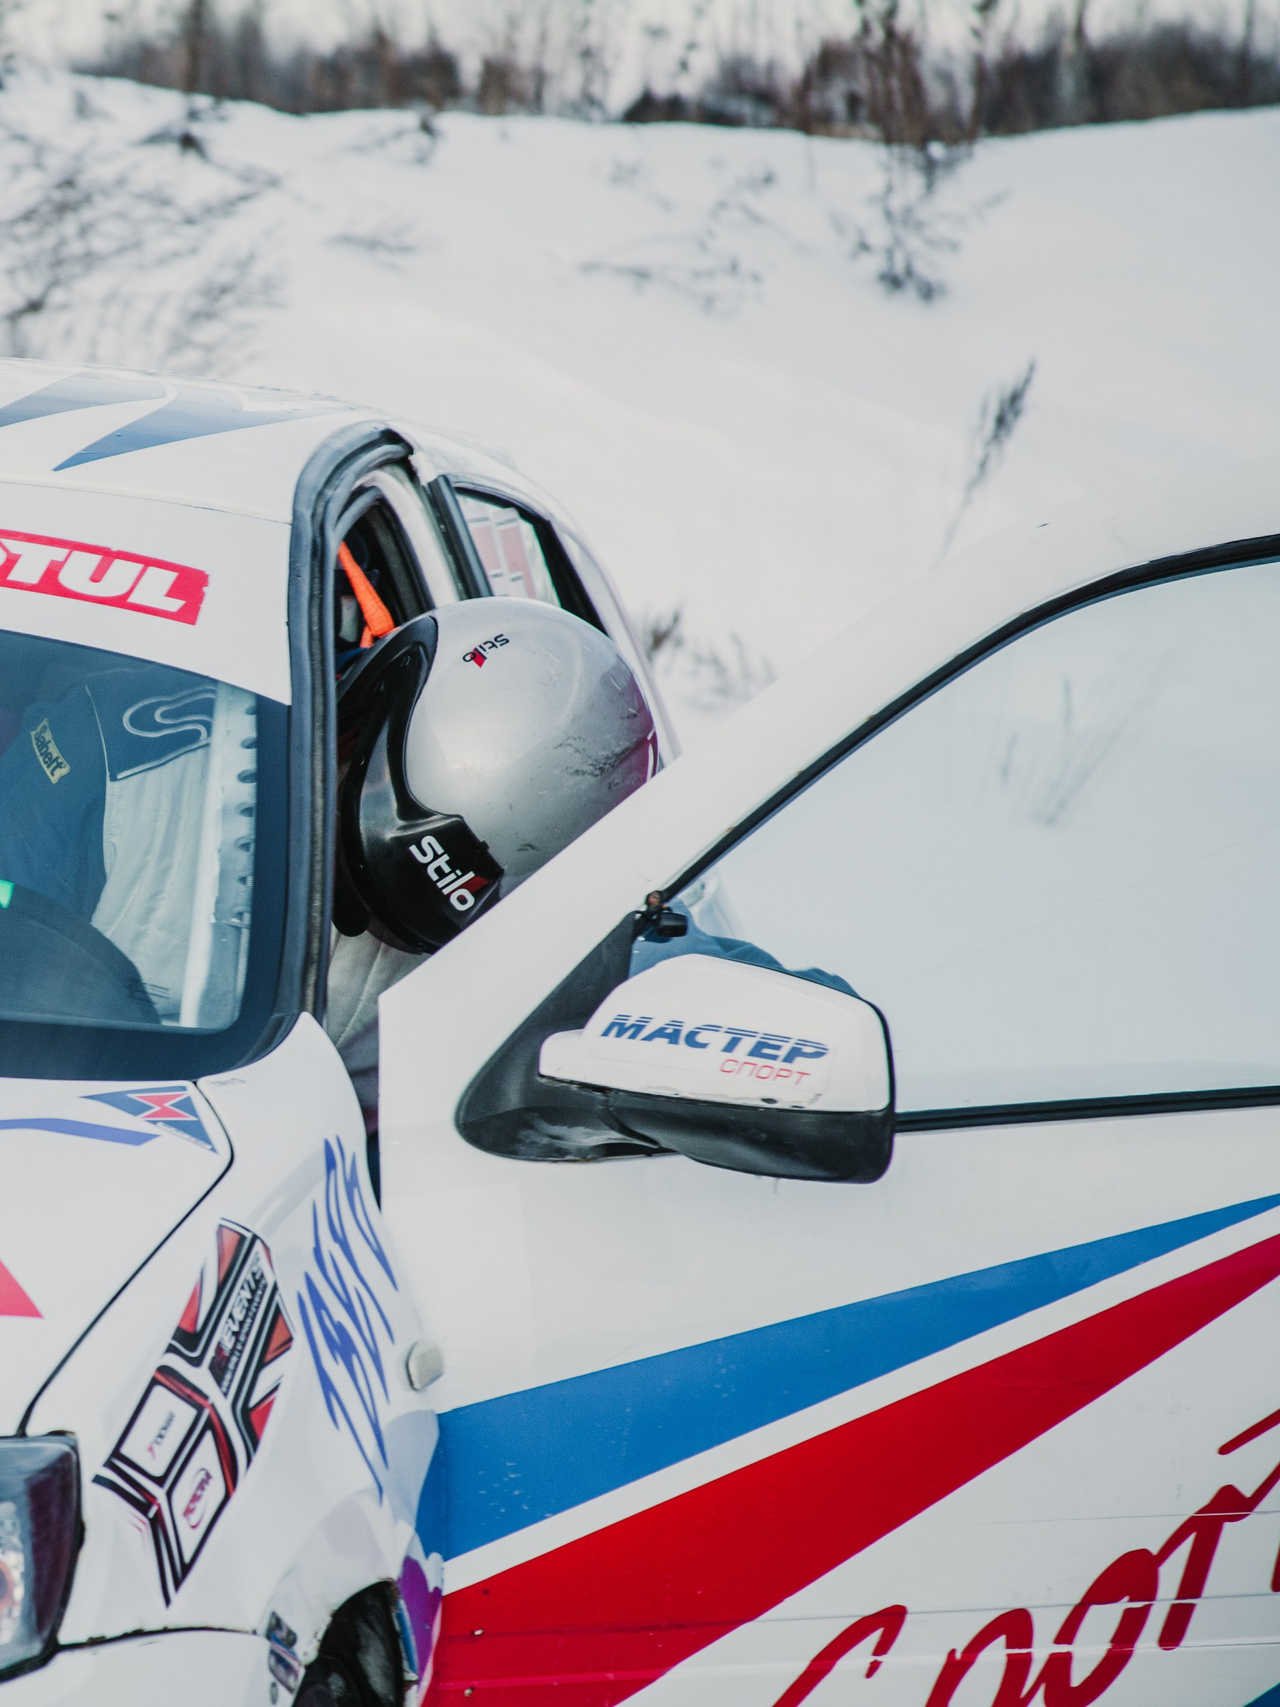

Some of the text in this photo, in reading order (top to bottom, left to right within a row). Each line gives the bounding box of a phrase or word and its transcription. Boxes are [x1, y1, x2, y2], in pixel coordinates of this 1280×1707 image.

[462, 634, 510, 664] Stilo
[33, 725, 65, 777] Sabelt
[409, 835, 476, 911] Stilo
[600, 1014, 830, 1064] МАСТЕР
[718, 1057, 812, 1086] СПОРТ
